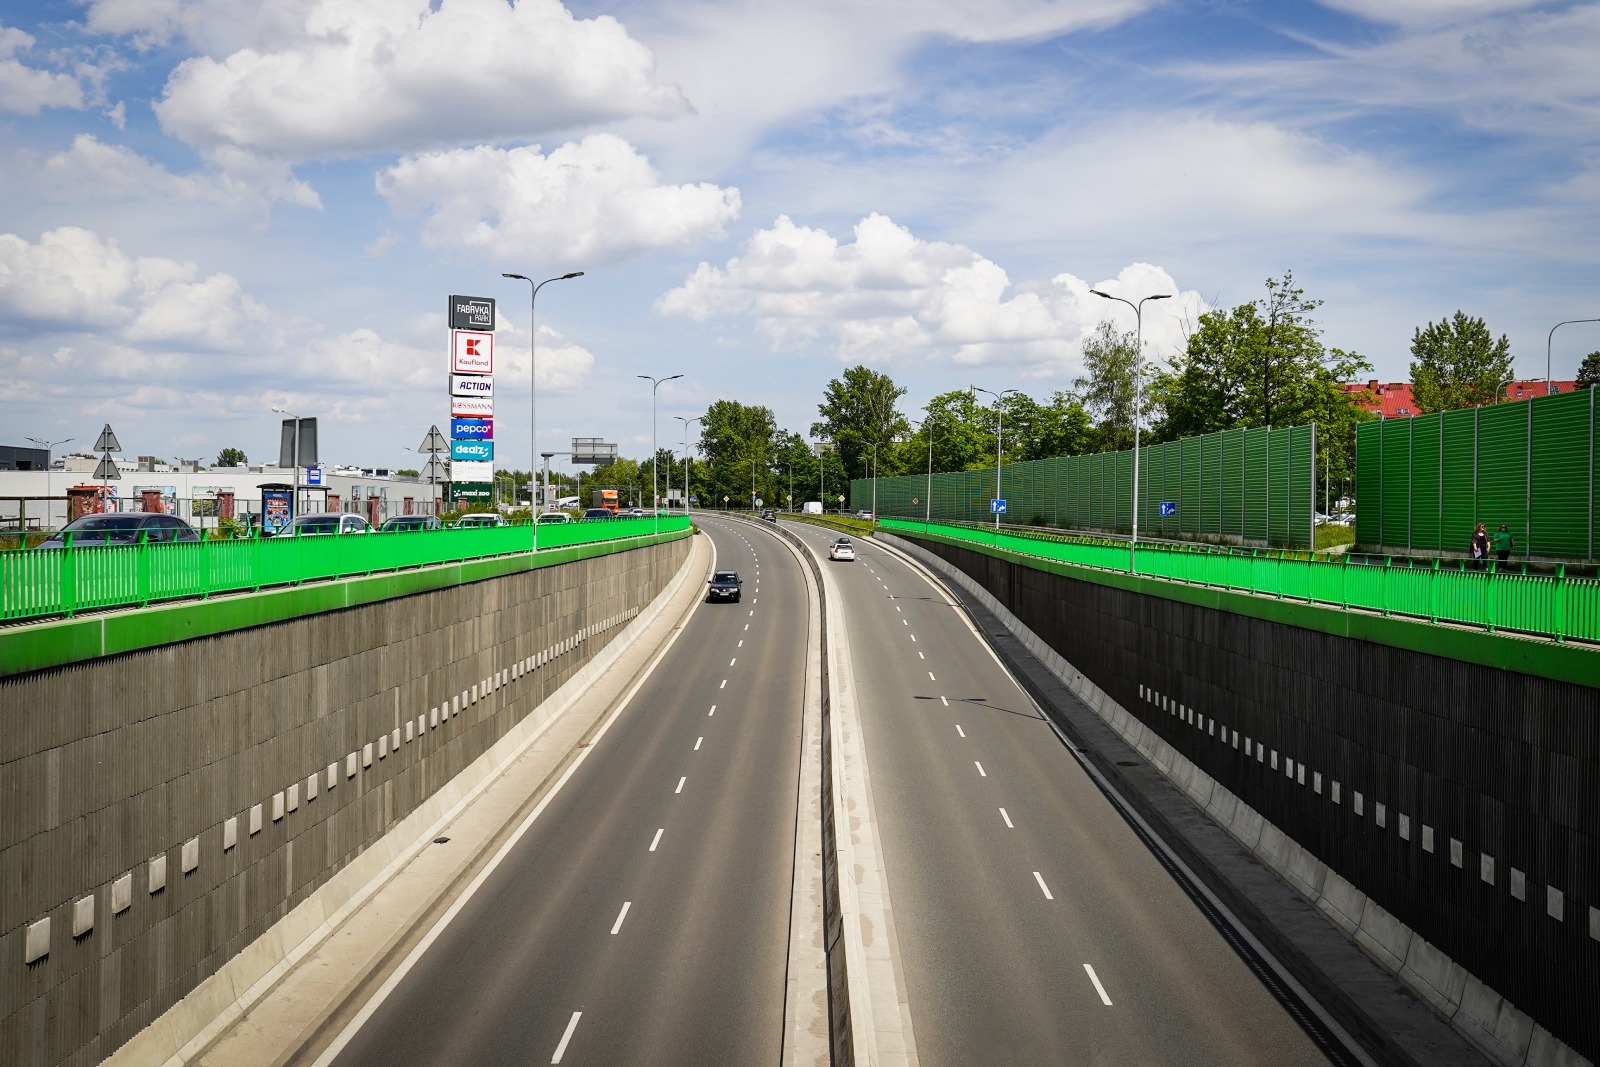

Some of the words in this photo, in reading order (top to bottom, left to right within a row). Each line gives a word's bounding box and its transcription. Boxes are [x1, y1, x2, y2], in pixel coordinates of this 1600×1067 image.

[457, 305, 489, 314] FABRYKA
[460, 382, 491, 391] ACTION
[456, 424, 488, 434] pepco
[456, 445, 484, 454] dealz
